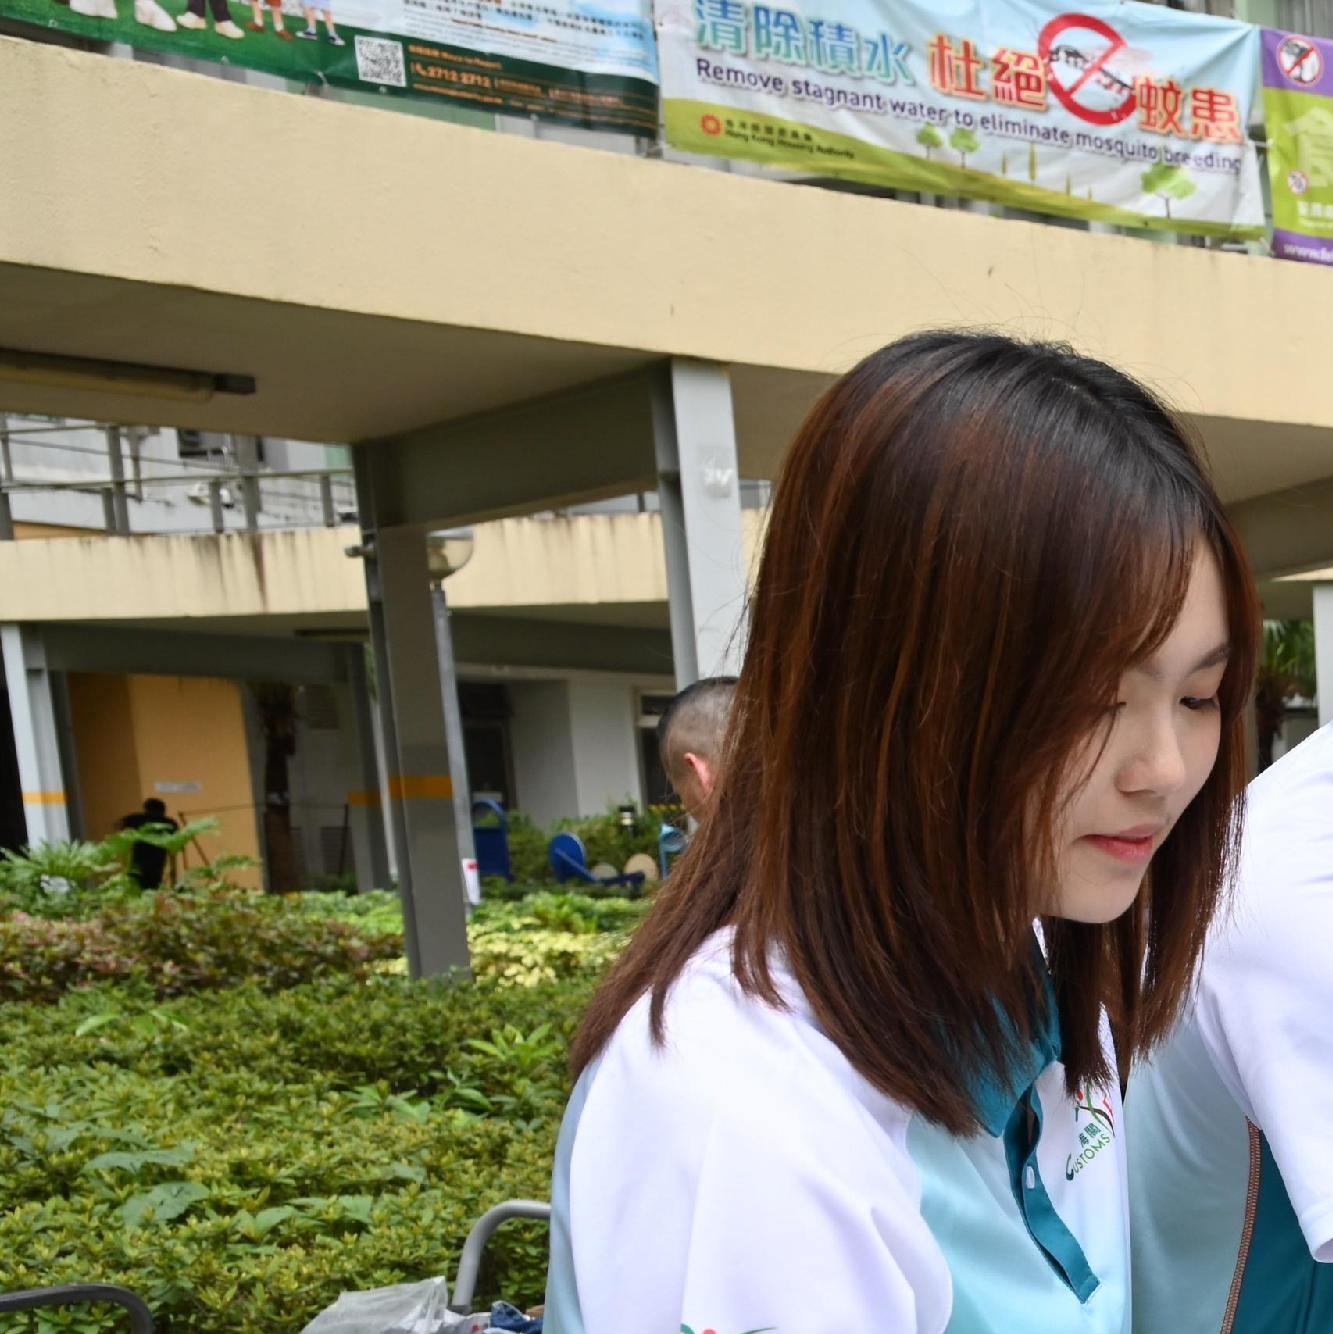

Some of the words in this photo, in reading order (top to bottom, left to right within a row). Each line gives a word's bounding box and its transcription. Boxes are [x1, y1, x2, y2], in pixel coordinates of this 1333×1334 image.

[696, 58, 783, 92] Remove
[792, 78, 881, 109] stagnant
[890, 100, 946, 121] water
[954, 110, 974, 127] to
[980, 115, 1070, 144] eliminate
[1075, 131, 1157, 160] mosquito
[1163, 148, 1242, 173] breeding
[697, 2, 914, 86] 清除積水
[930, 34, 1049, 111] 杜絕
[1136, 74, 1244, 144] 蚊患
[1066, 1133, 1110, 1181] CUSTOMS
